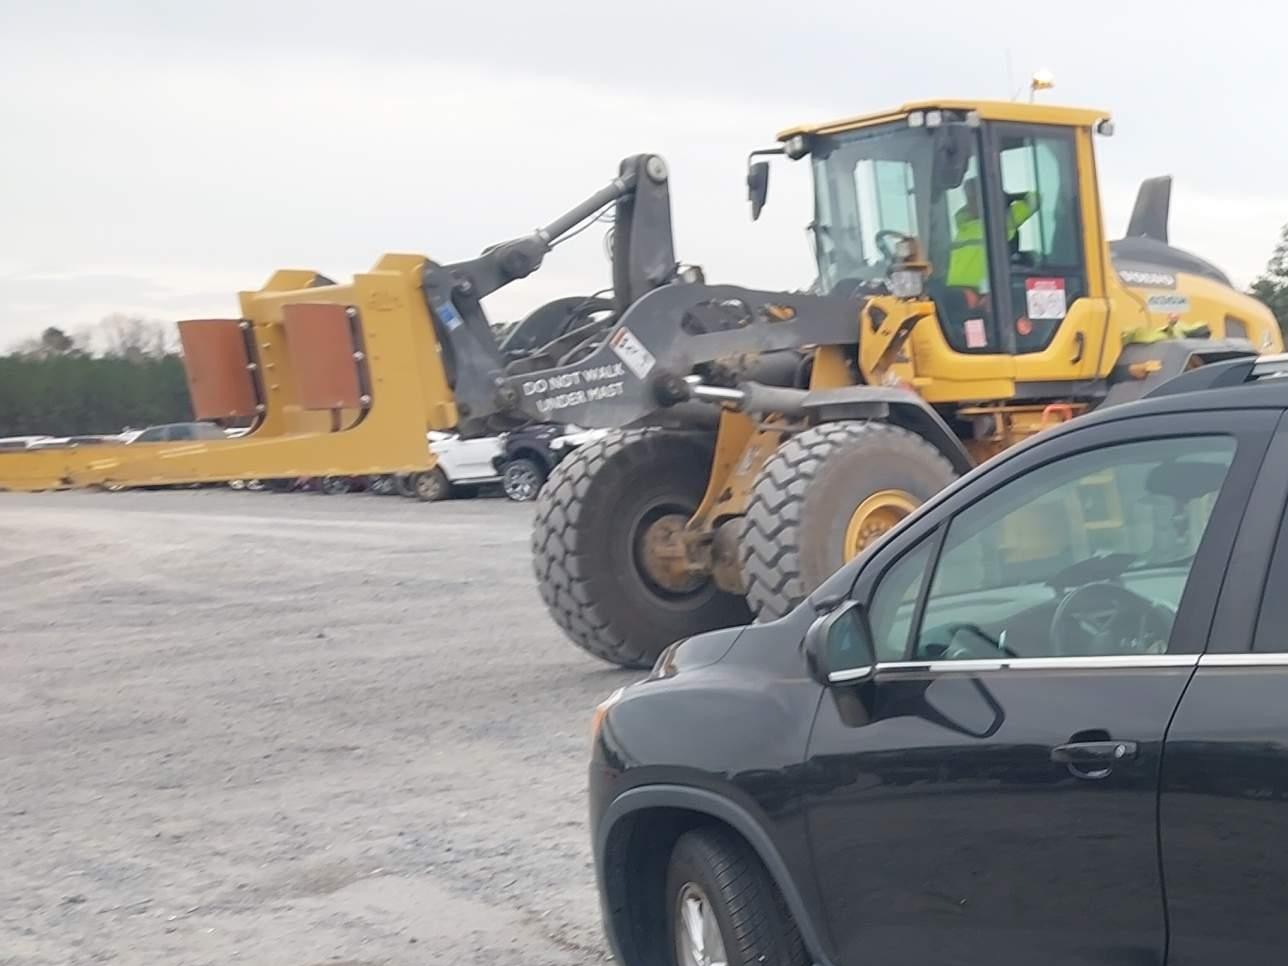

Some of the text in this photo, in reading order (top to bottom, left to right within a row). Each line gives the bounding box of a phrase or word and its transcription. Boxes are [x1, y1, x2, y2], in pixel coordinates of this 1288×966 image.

[522, 362, 625, 396] DO NOT WALK
[536, 381, 624, 412] UNDER MAST
